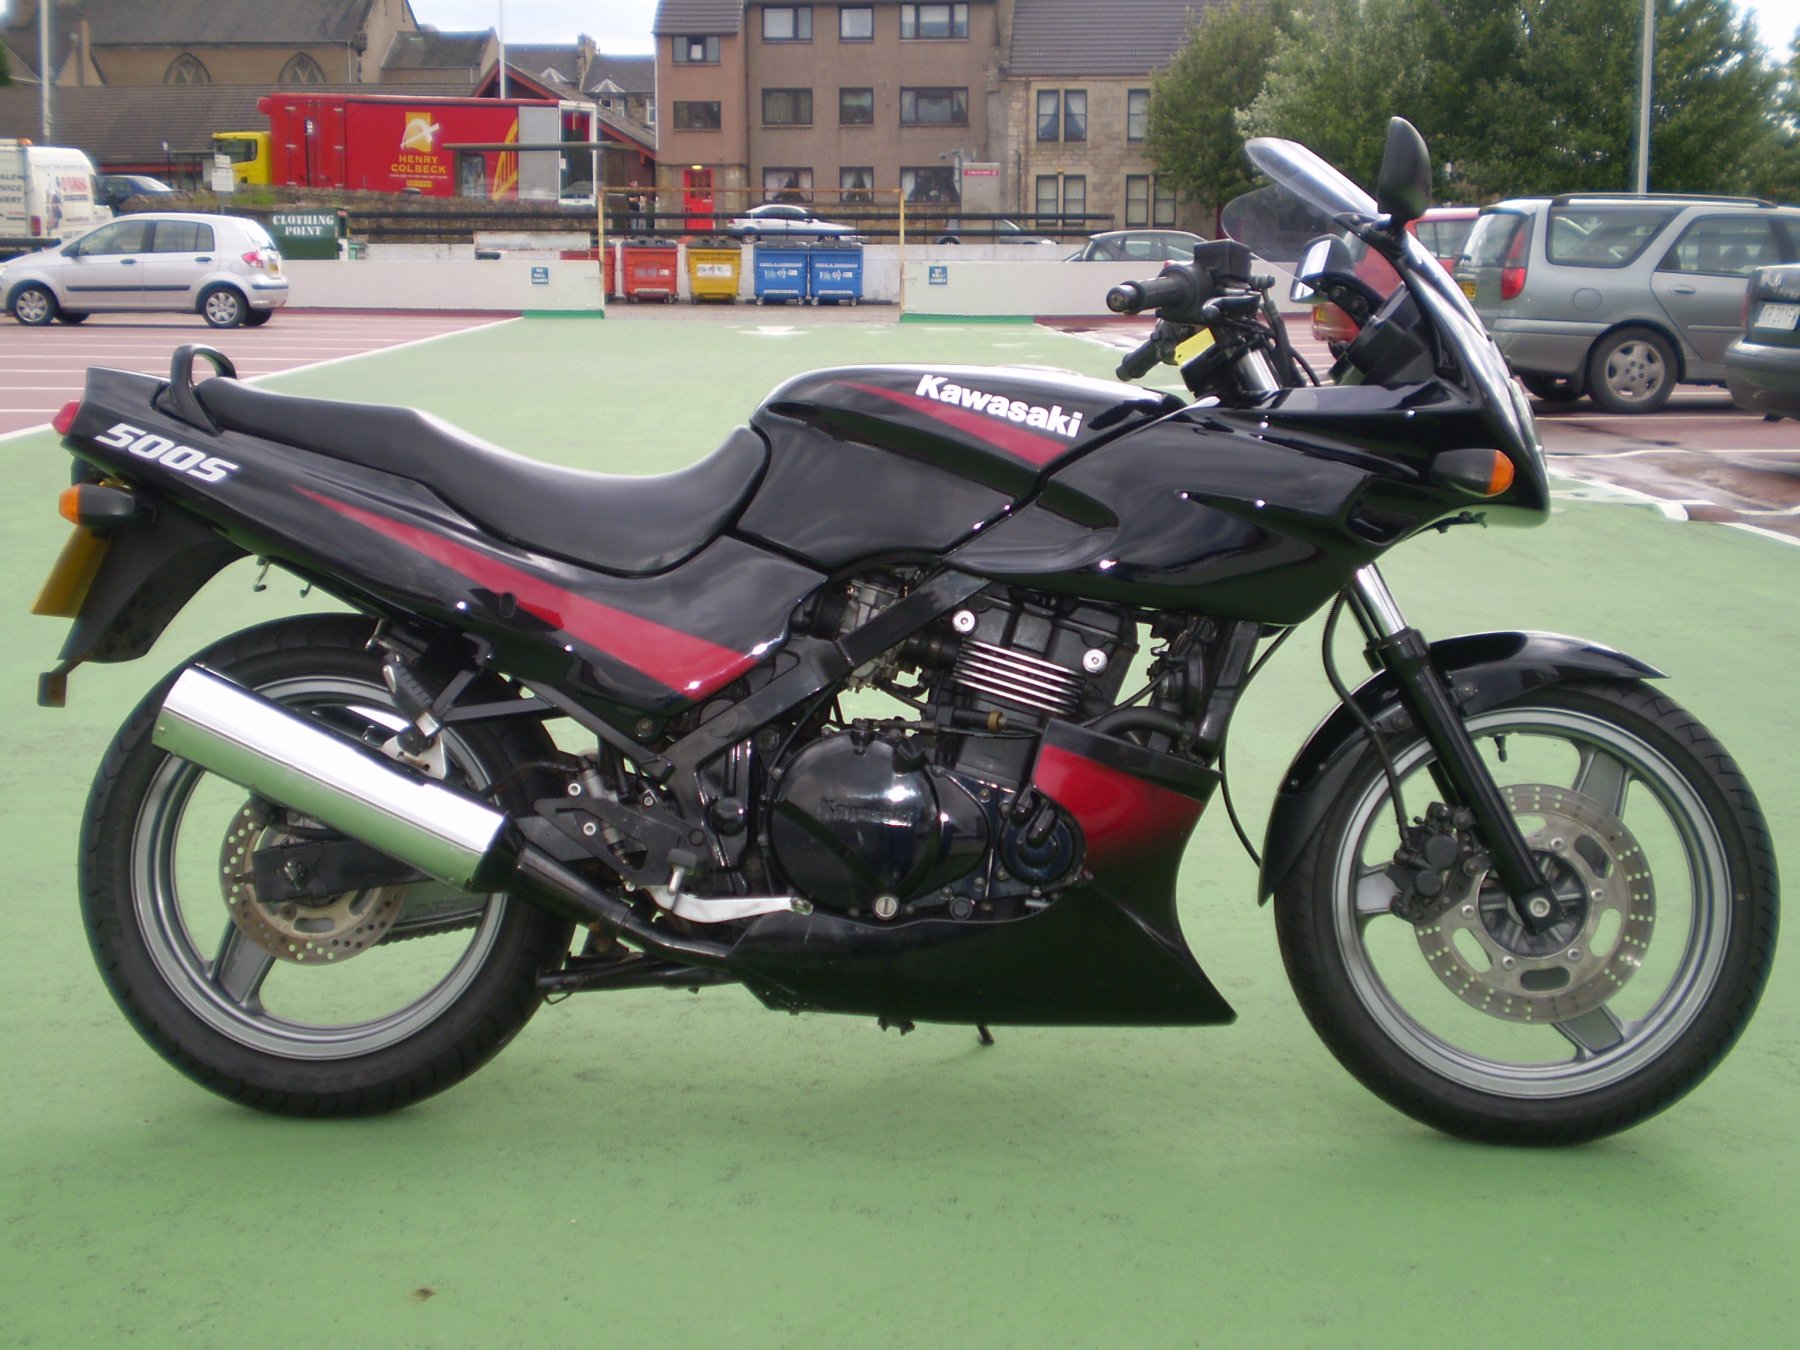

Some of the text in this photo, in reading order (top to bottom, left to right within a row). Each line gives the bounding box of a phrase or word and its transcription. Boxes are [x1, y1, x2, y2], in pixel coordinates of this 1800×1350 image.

[399, 154, 438, 163] HENRY
[390, 163, 447, 174] COLBECK
[272, 214, 334, 225] CLOTHING
[285, 225, 322, 236] POINT
[915, 373, 1083, 438] Kawasaki
[94, 422, 239, 482] 500S
